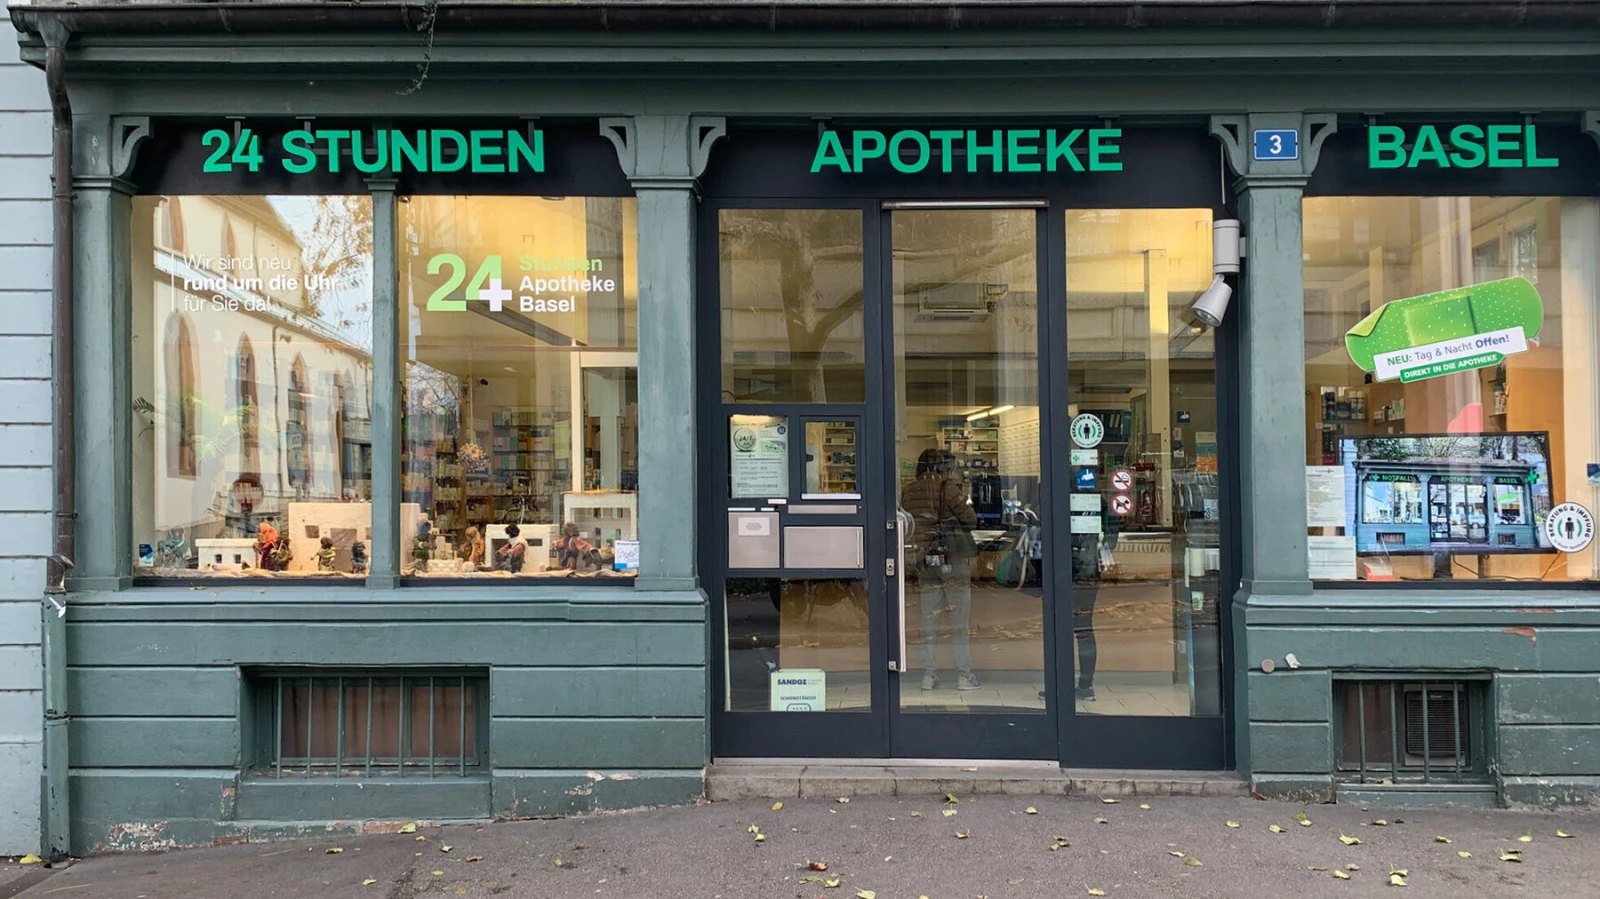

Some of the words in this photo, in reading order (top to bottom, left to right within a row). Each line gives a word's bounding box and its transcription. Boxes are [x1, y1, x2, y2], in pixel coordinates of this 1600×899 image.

[201, 129, 263, 173] 24
[282, 129, 546, 173] STUNDEN
[810, 128, 1124, 174] APOTHEKE
[1268, 134, 1283, 155] 3
[1367, 124, 1560, 169] BASEL
[183, 254, 211, 271] Wir
[218, 254, 253, 271] sind
[259, 257, 291, 271] neu
[519, 255, 603, 272] Stunden
[183, 274, 228, 291] rund
[233, 278, 262, 291] um
[269, 274, 299, 291] die
[304, 274, 339, 291] Uhr
[426, 253, 513, 312] 24
[519, 275, 615, 295] Apotheke
[183, 295, 207, 311] für
[211, 295, 239, 311] Sie
[519, 296, 575, 312] Basel
[1387, 355, 1413, 367] NEU:
[1414, 351, 1432, 362] Tag
[1435, 348, 1442, 356] &
[1445, 342, 1473, 355] Nacht
[1475, 334, 1510, 349] Offen!
[1404, 367, 1431, 379] DIREKT
[1433, 365, 1442, 373] IN
[1443, 362, 1456, 371] DIE
[1458, 354, 1498, 368] APOTHEKE
[1072, 415, 1086, 438] BERATUNG
[1381, 474, 1412, 482] NOTFALL
[1548, 505, 1568, 537] BERATUNG
[1576, 508, 1592, 538] IMPFUNG
